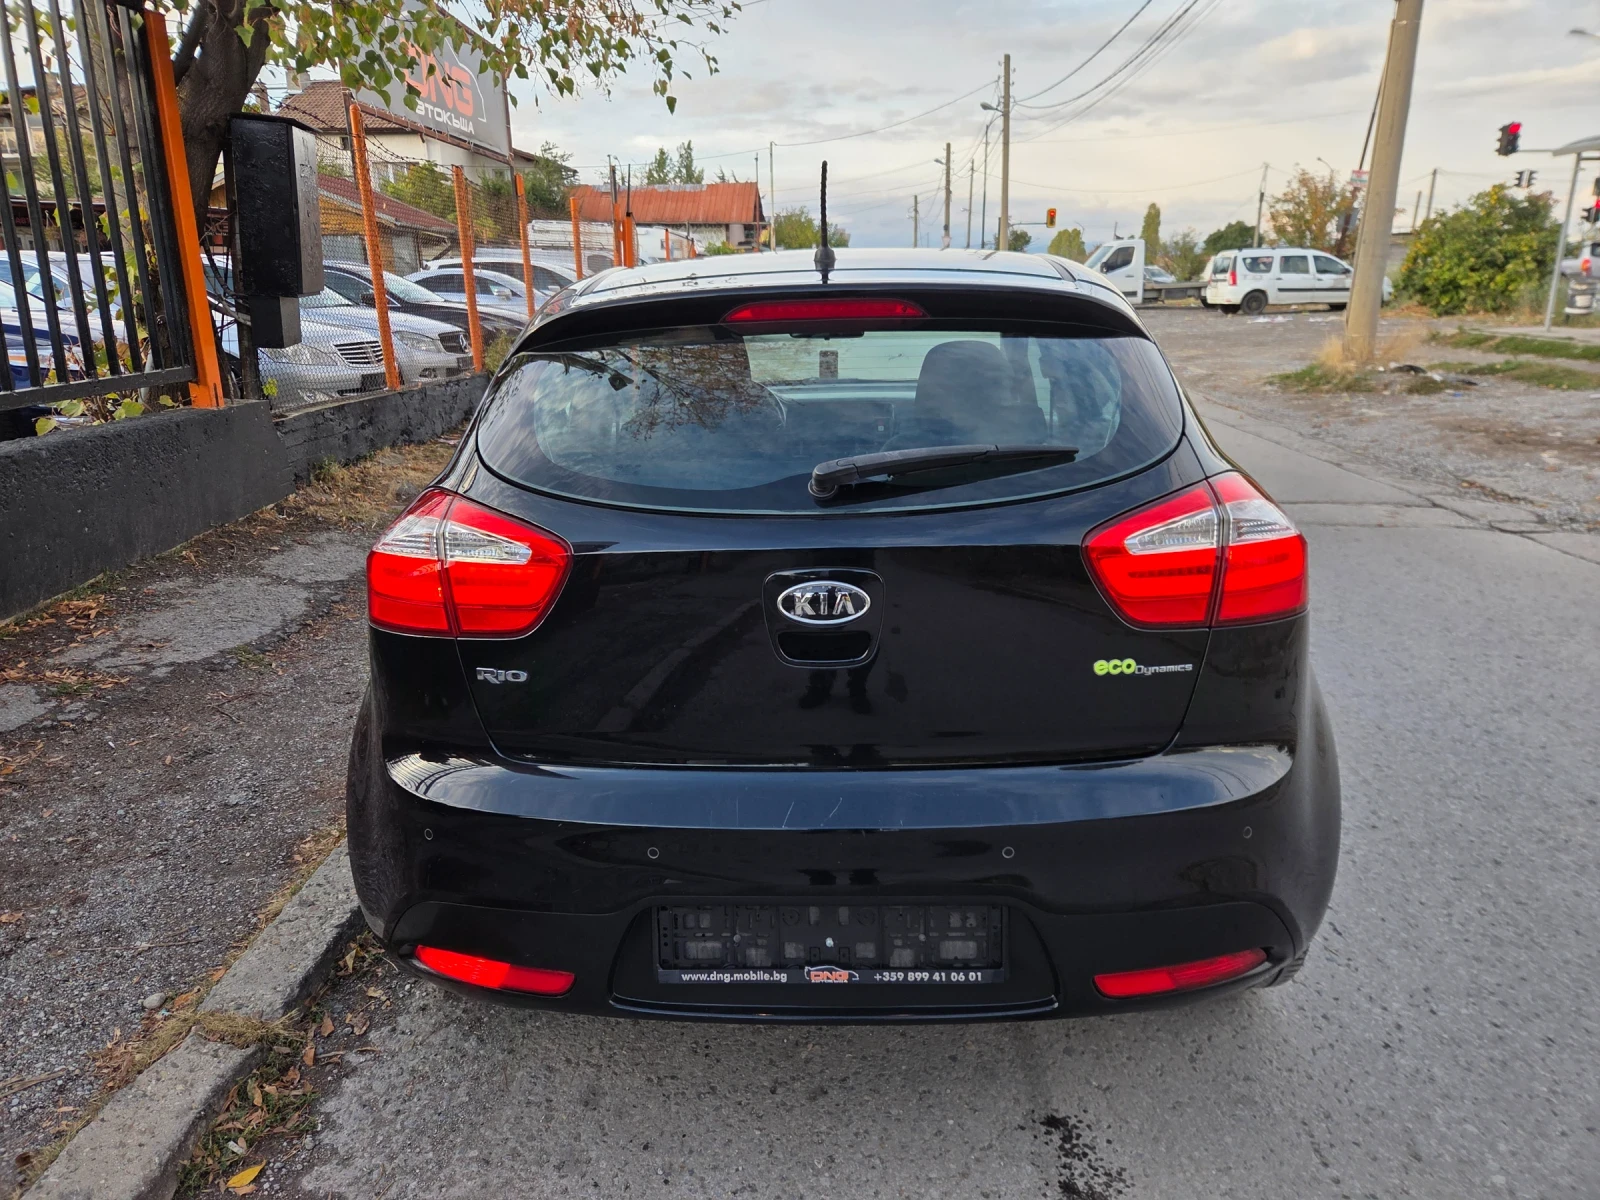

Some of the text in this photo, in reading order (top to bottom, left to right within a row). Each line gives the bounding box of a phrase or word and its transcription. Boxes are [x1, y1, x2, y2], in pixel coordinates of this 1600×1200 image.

[793, 591, 856, 616] KIA
[476, 667, 528, 684] RIO
[681, 970, 788, 983] www.dng.mobile.bg
[873, 971, 982, 982] +359 899 41 06 01
